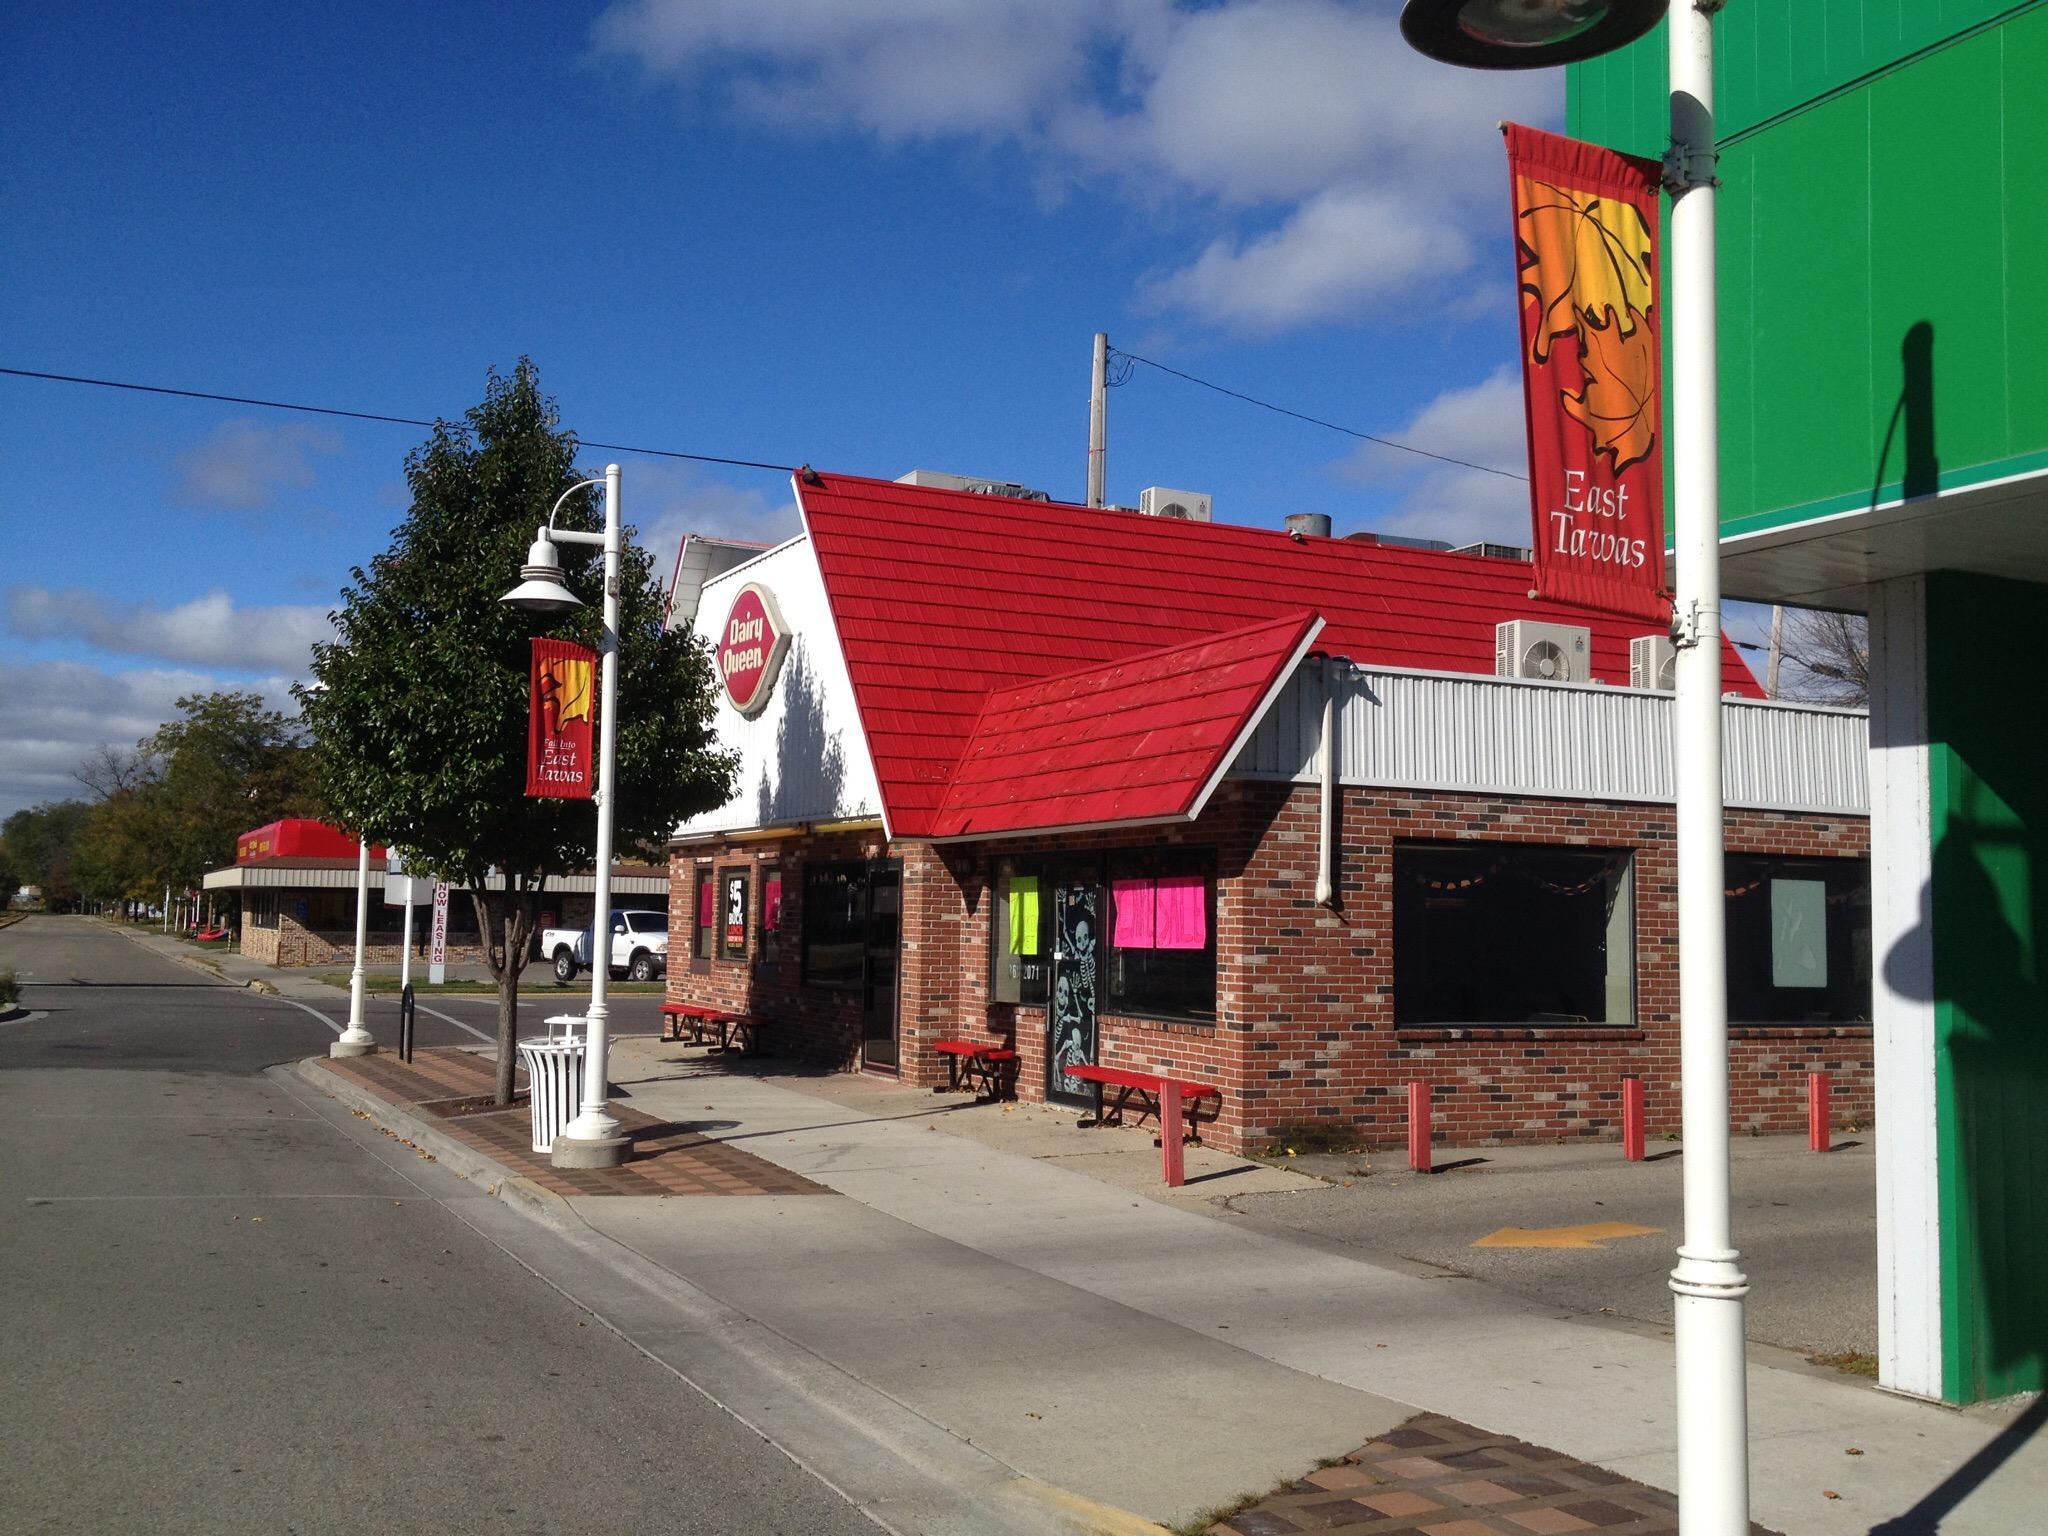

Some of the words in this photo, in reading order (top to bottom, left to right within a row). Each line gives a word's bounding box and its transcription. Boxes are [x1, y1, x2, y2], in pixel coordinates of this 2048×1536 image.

[1564, 470, 1629, 520] East
[1550, 511, 1646, 569] Tawas
[730, 611, 763, 645] Dairy
[723, 647, 762, 680] Queen
[537, 764, 584, 783] Tawas
[541, 749, 577, 766] East
[436, 883, 448, 907] NOW
[729, 880, 742, 914] $5
[728, 912, 743, 925] BUCK
[433, 909, 445, 963] LEASING
